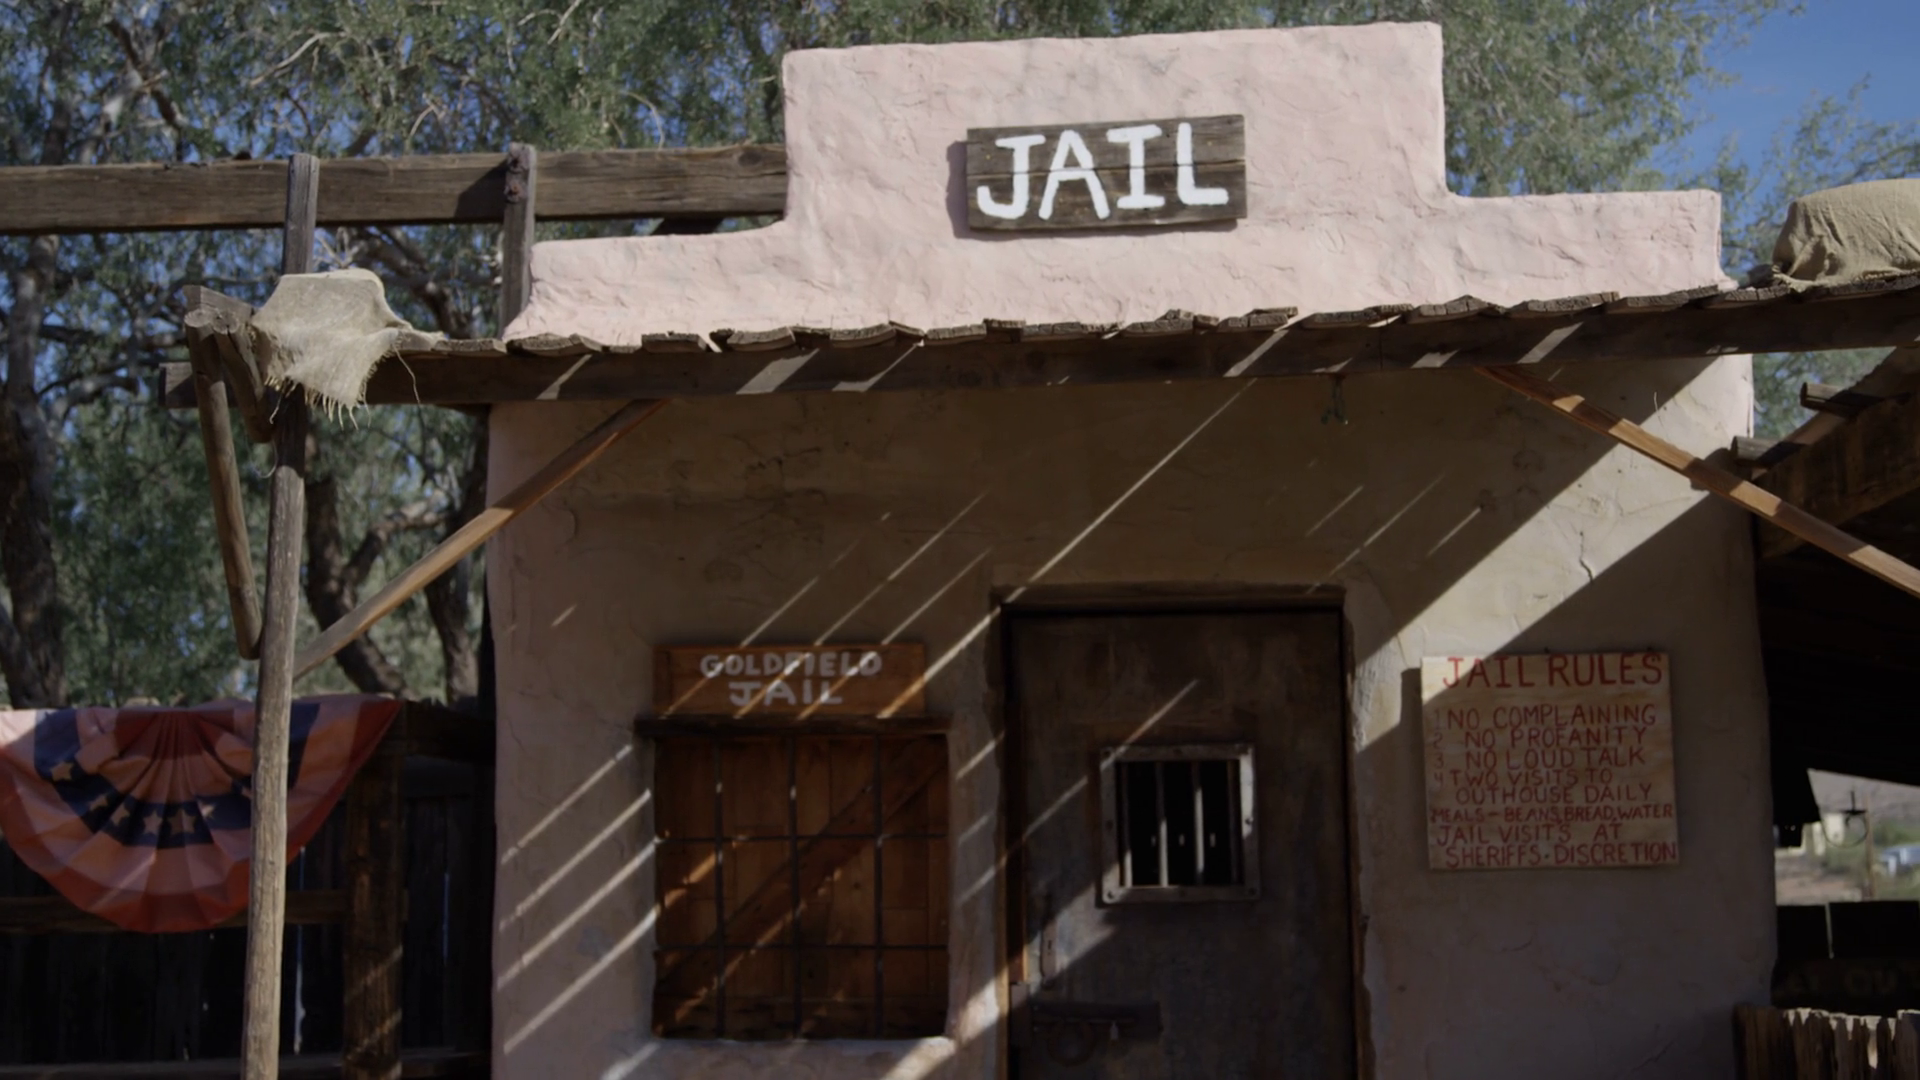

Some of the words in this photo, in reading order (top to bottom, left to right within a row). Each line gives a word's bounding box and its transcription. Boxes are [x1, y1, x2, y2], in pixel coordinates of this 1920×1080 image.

[977, 122, 1229, 220] JAIL
[700, 651, 882, 679] GOLDFIELD
[1442, 654, 1536, 688] JAIL
[1549, 652, 1663, 687] RULES
[728, 680, 842, 707] JAIL
[1447, 708, 1480, 730] NO
[1493, 703, 1656, 729] COMPLAINING
[1464, 728, 1496, 751] NO
[1510, 725, 1647, 749] PROFANITY
[1465, 749, 1497, 772] NO
[1506, 748, 1576, 770] LOUD
[1582, 745, 1647, 768] TALK
[1449, 768, 1499, 788] TWO
[1508, 768, 1579, 786] VISITS
[1586, 767, 1613, 785] TO
[1456, 785, 1574, 805] OUTHOUSE
[1585, 782, 1652, 803] DAILY
[1436, 824, 1490, 847] JAIL
[1500, 823, 1572, 845] VISITS
[1593, 822, 1623, 841] AT
[1554, 841, 1676, 866] DISCRETION
